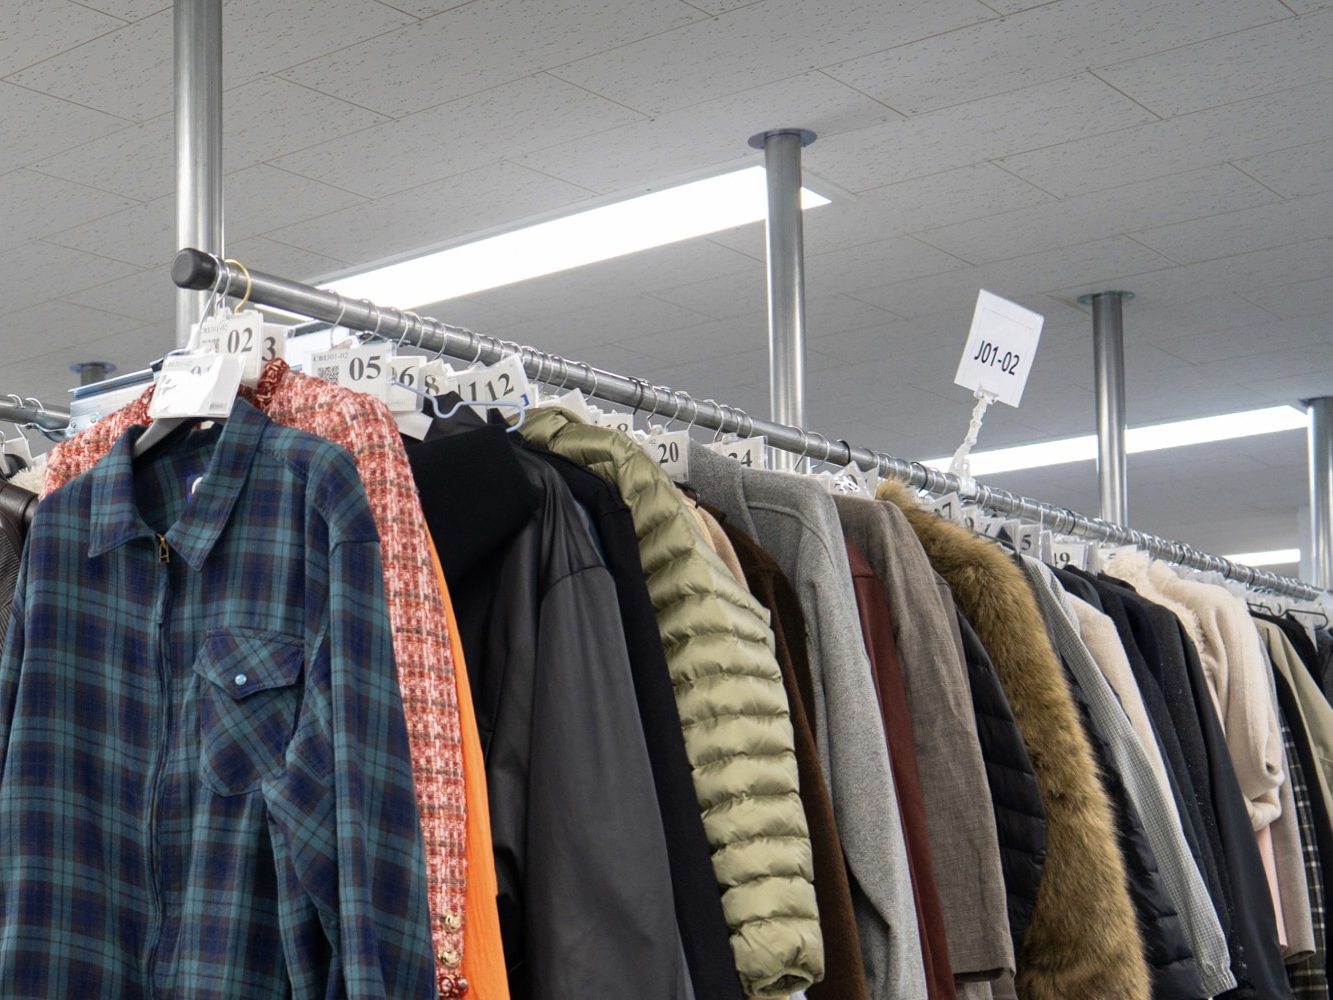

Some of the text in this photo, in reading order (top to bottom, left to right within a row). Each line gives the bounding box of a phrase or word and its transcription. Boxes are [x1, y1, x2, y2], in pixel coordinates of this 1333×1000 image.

[227, 328, 253, 354] 02
[349, 355, 381, 381] 05
[974, 340, 1020, 376] J01-02
[424, 374, 441, 398] 8
[485, 373, 514, 402] 12
[657, 441, 678, 464] 20
[1021, 533, 1032, 551] 5
